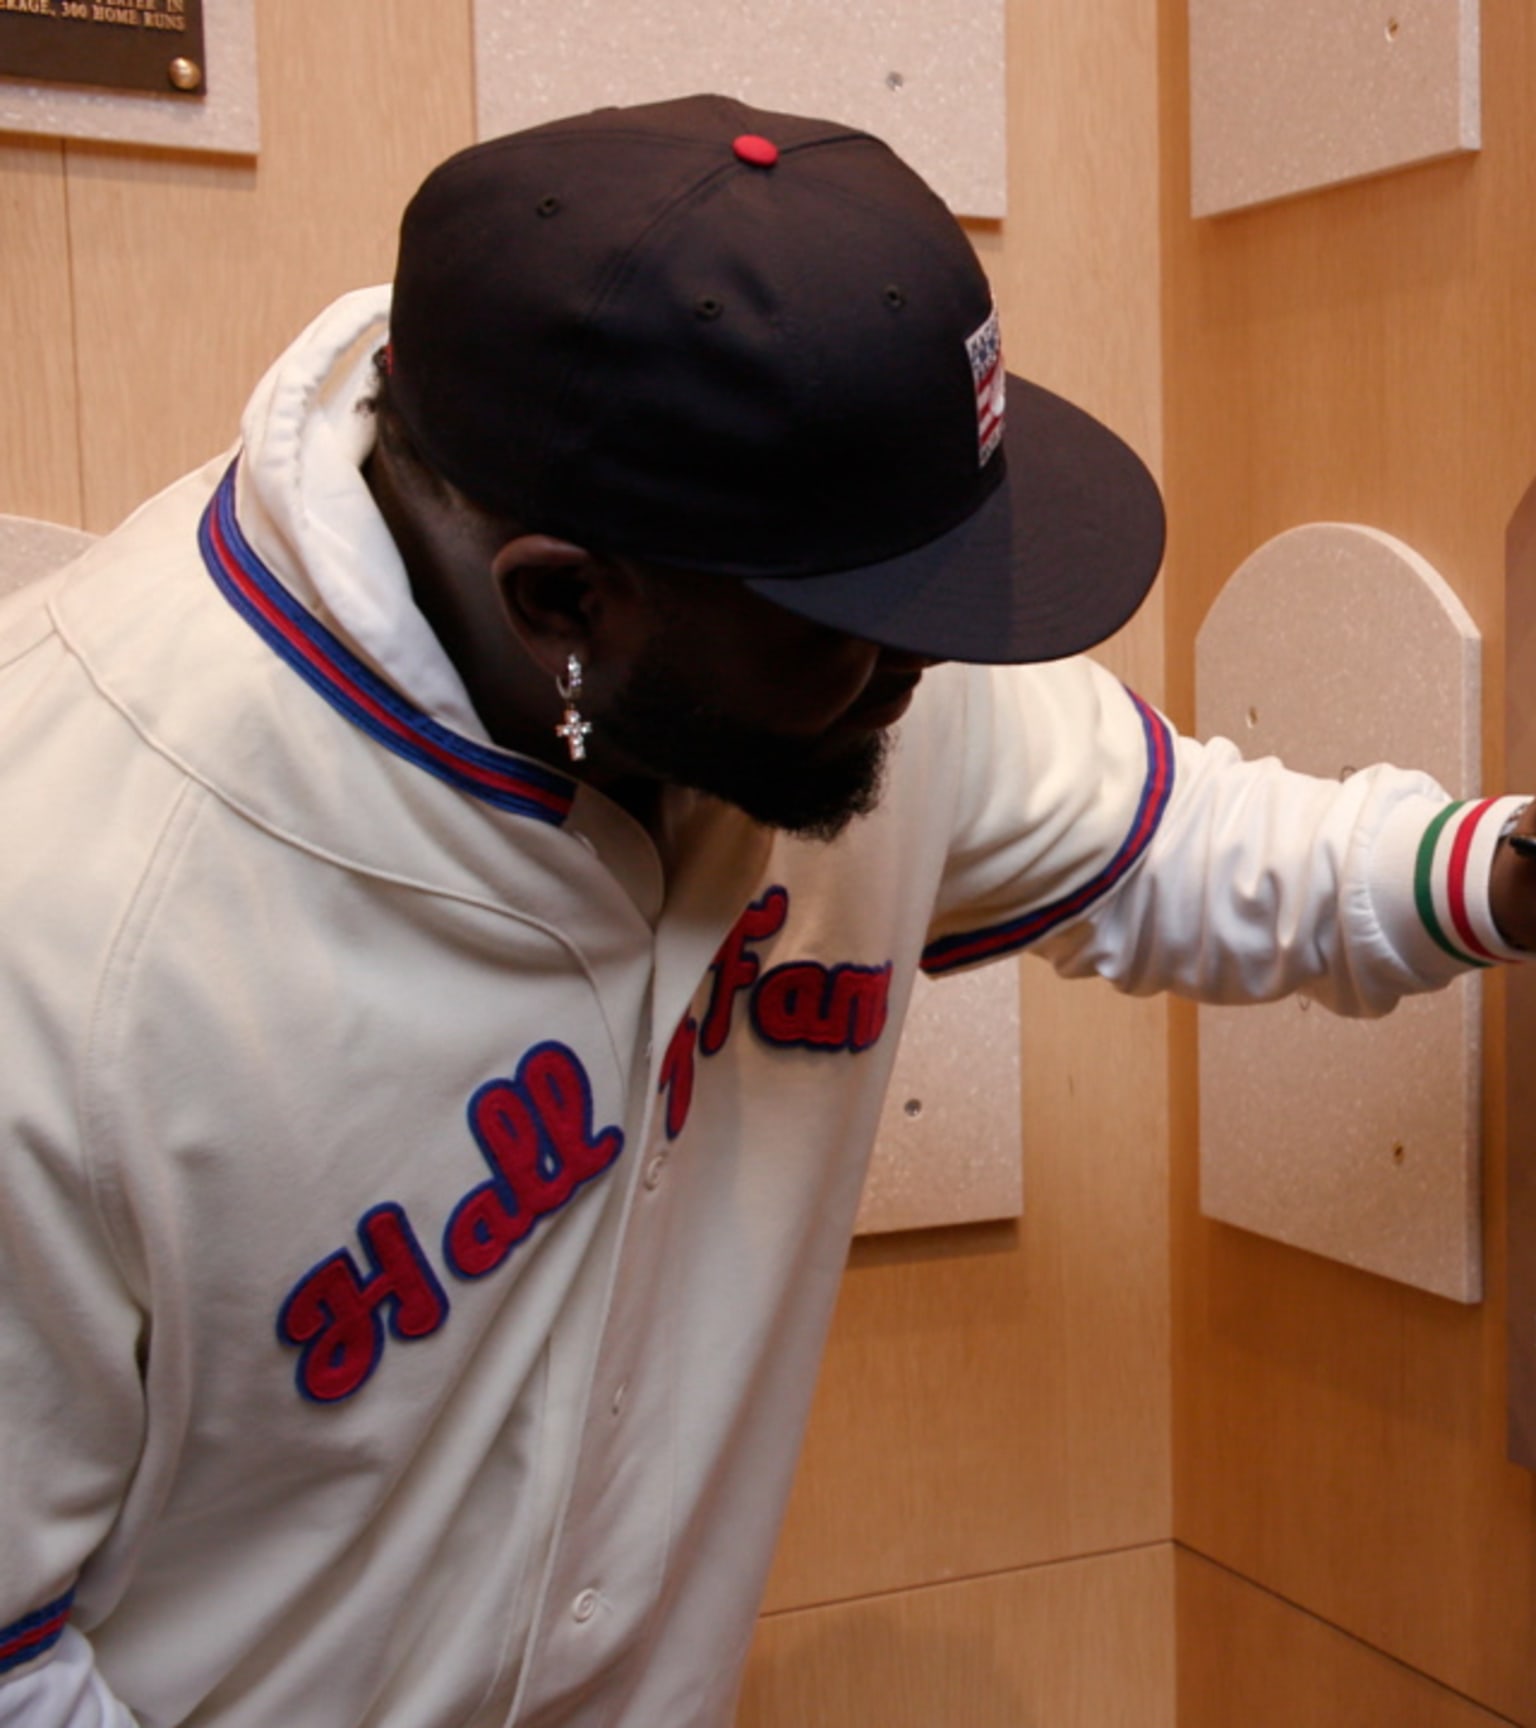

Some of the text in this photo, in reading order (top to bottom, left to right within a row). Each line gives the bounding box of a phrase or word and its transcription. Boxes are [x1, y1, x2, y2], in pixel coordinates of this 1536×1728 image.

[93, 5, 139, 25] HOME
[143, 11, 186, 31] RUNS
[276, 1040, 625, 1403] Hall
[699, 884, 894, 1057] Fam
